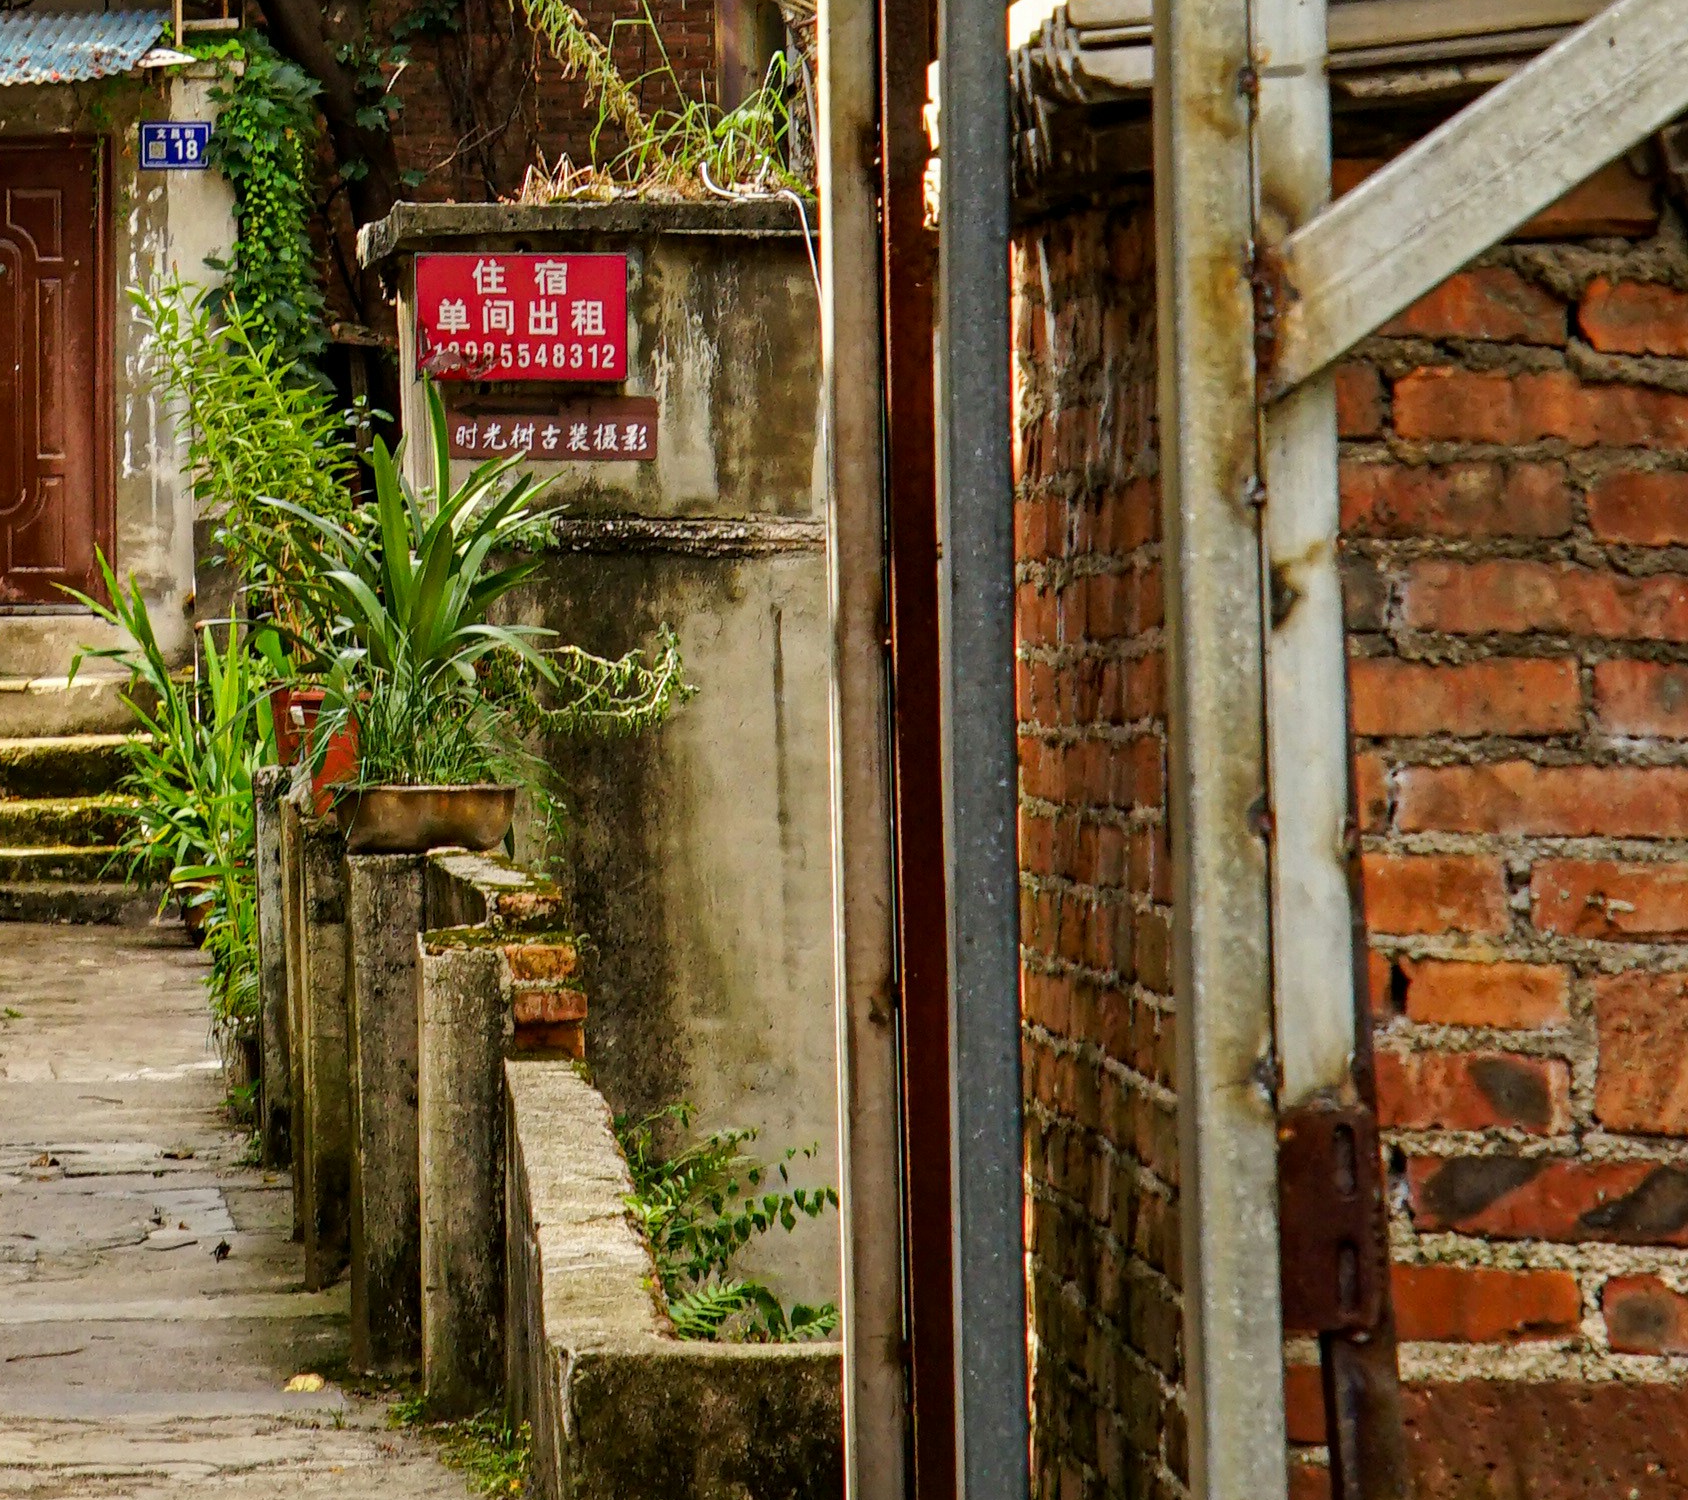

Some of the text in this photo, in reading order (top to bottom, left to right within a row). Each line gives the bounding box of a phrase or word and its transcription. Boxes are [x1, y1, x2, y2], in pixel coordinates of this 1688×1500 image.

[174, 139, 199, 160] 18
[472, 258, 568, 296] 住宿
[436, 298, 606, 336] 单间出租
[455, 422, 648, 452] 时光树古装摄影
